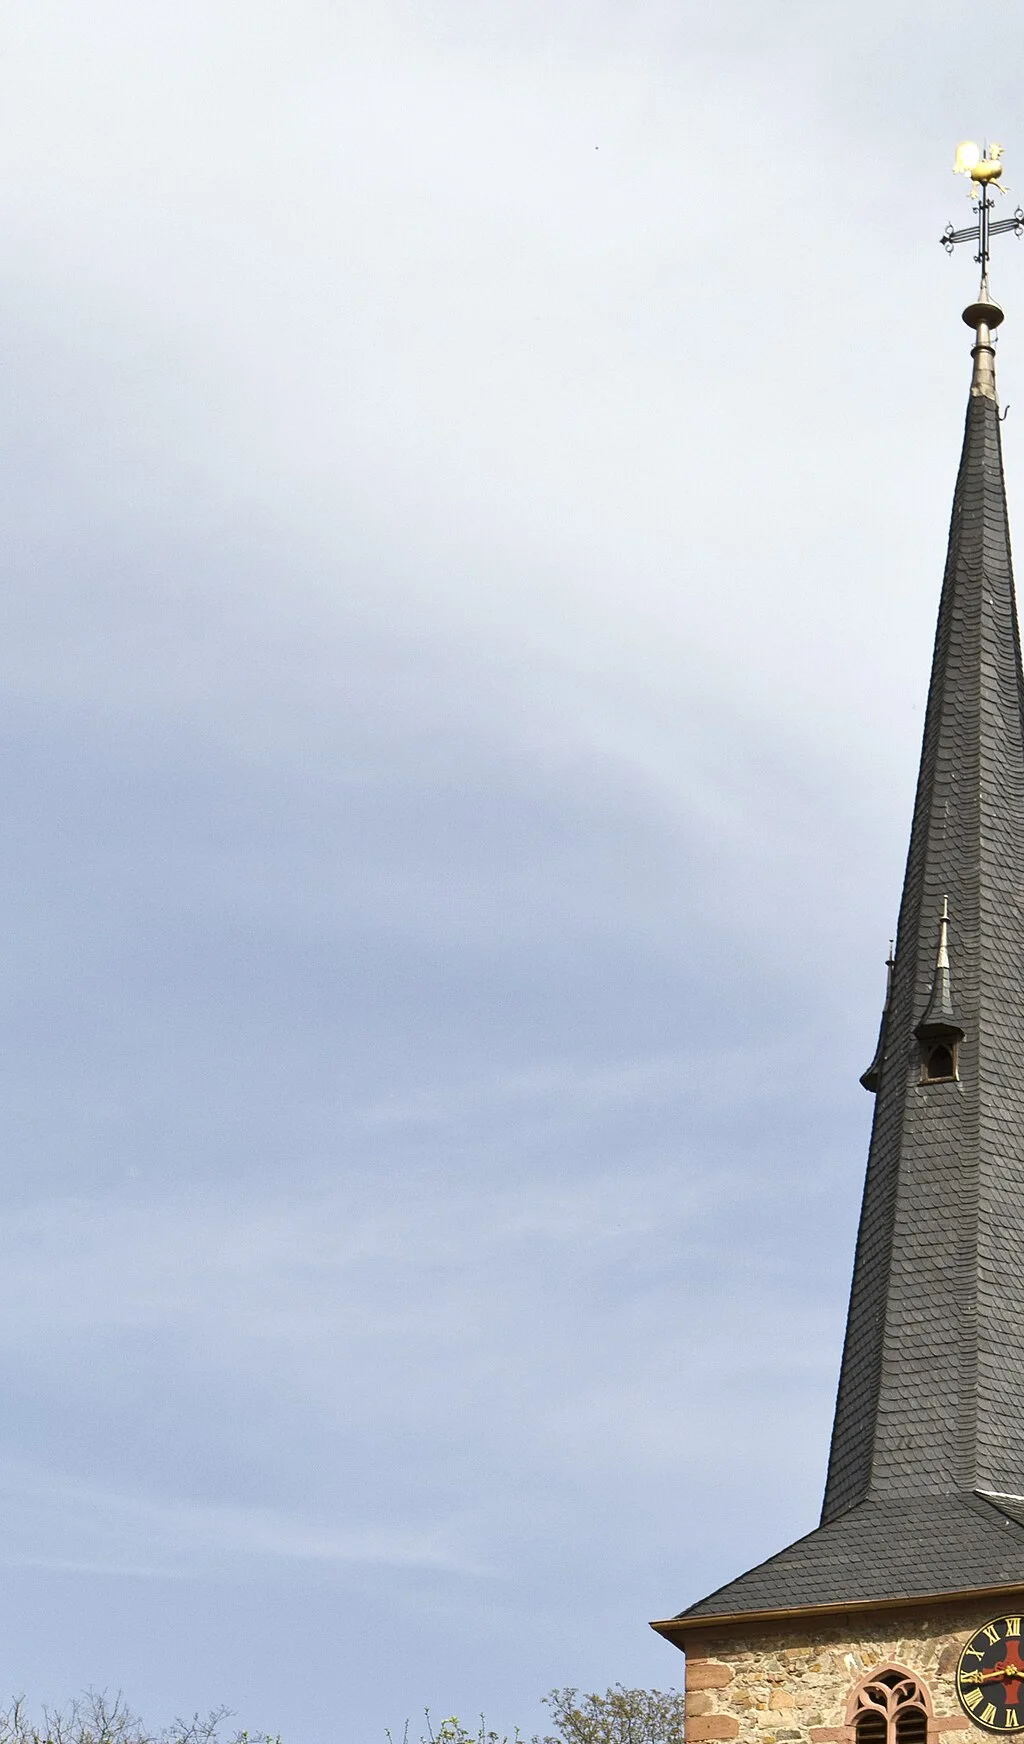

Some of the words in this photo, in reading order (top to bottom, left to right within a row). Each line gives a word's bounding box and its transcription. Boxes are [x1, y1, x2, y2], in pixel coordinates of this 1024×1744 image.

[982, 1624, 1001, 1646] XI
[1005, 1617, 1021, 1637] XII
[965, 1644, 985, 1662] X
[963, 1687, 984, 1711] VIII
[979, 1702, 997, 1725] VII
[1004, 1708, 1019, 1727] VI
